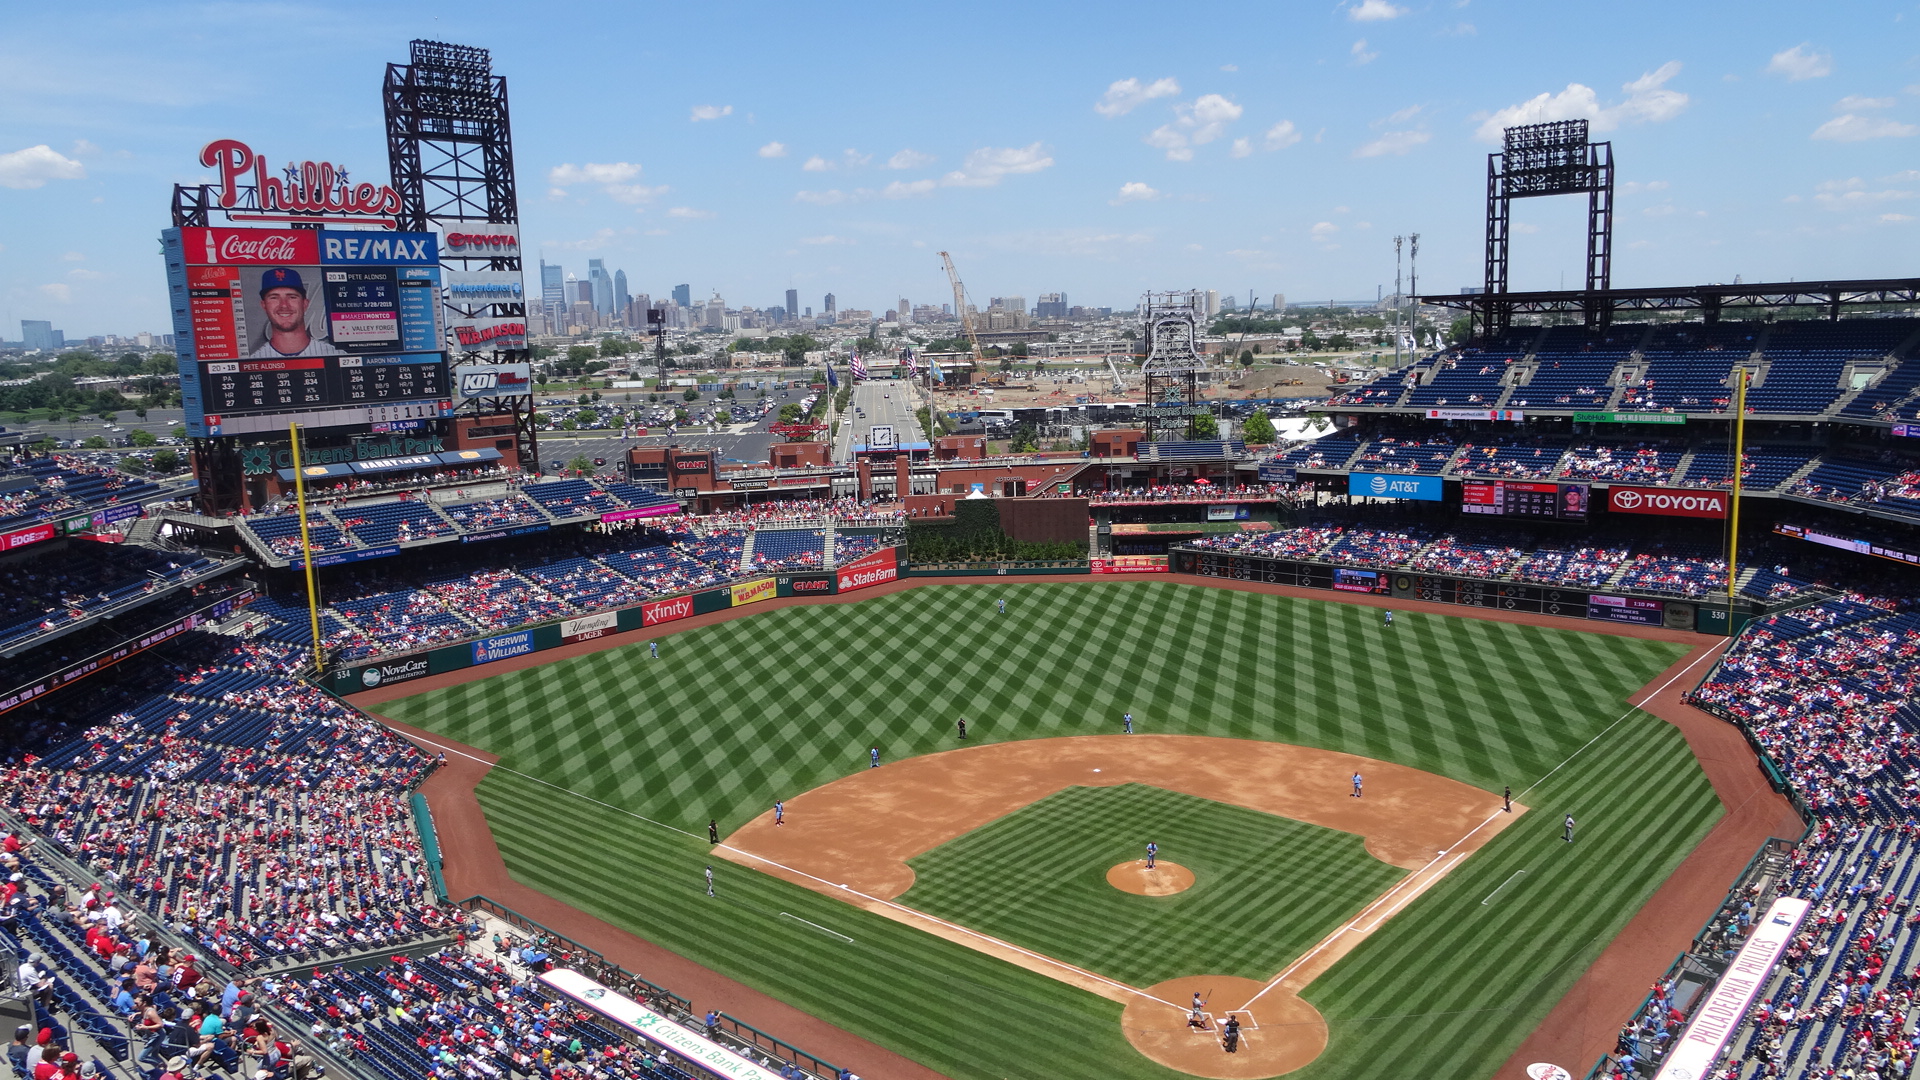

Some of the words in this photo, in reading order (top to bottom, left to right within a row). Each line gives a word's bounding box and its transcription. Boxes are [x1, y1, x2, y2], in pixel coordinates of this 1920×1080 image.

[199, 139, 403, 215] Phillies
[221, 234, 298, 260] Coca-Cola
[465, 234, 517, 246] TOYOTA
[325, 238, 428, 260] RE/MAX
[450, 283, 511, 293] Independence
[260, 362, 286, 370] ALONSO
[250, 381, 264, 389] .281
[464, 374, 498, 390] KDI
[305, 394, 320, 402] 25.5
[405, 407, 412, 419] 1
[417, 406, 424, 418] 1
[429, 405, 437, 417] 1
[1134, 405, 1180, 417] Citizens
[1181, 404, 1211, 416] Bank
[398, 421, 418, 429] 4,380
[1159, 416, 1186, 429] Park
[1661, 415, 1683, 423] TICKETS
[356, 438, 404, 459] Bank
[404, 435, 445, 454] Park
[359, 459, 398, 470] HARRY
[414, 456, 432, 464] K'S
[676, 461, 707, 470] GIANT
[1389, 480, 1420, 494] AT&T
[1644, 494, 1723, 512] TOYOTA
[74, 517, 89, 529] NFP
[10, 532, 36, 547] EDGE
[468, 533, 491, 542] Jefferson
[793, 580, 829, 591] GIANT
[1591, 595, 1624, 606] Phillies.com
[646, 600, 691, 623] xfinity
[1711, 611, 1726, 620] 330
[569, 615, 611, 634] Yuengling
[488, 634, 528, 650] SHERWIN
[578, 629, 603, 641] LAGER
[336, 670, 351, 680] 334
[382, 660, 428, 677] NovaCare
[382, 669, 427, 684] REHABILITATION
[1735, 937, 1779, 976] PHILLIES
[1689, 977, 1755, 1046] PHILADELPHIA
[655, 1024, 705, 1055] Citizens
[705, 1050, 741, 1073] Bank
